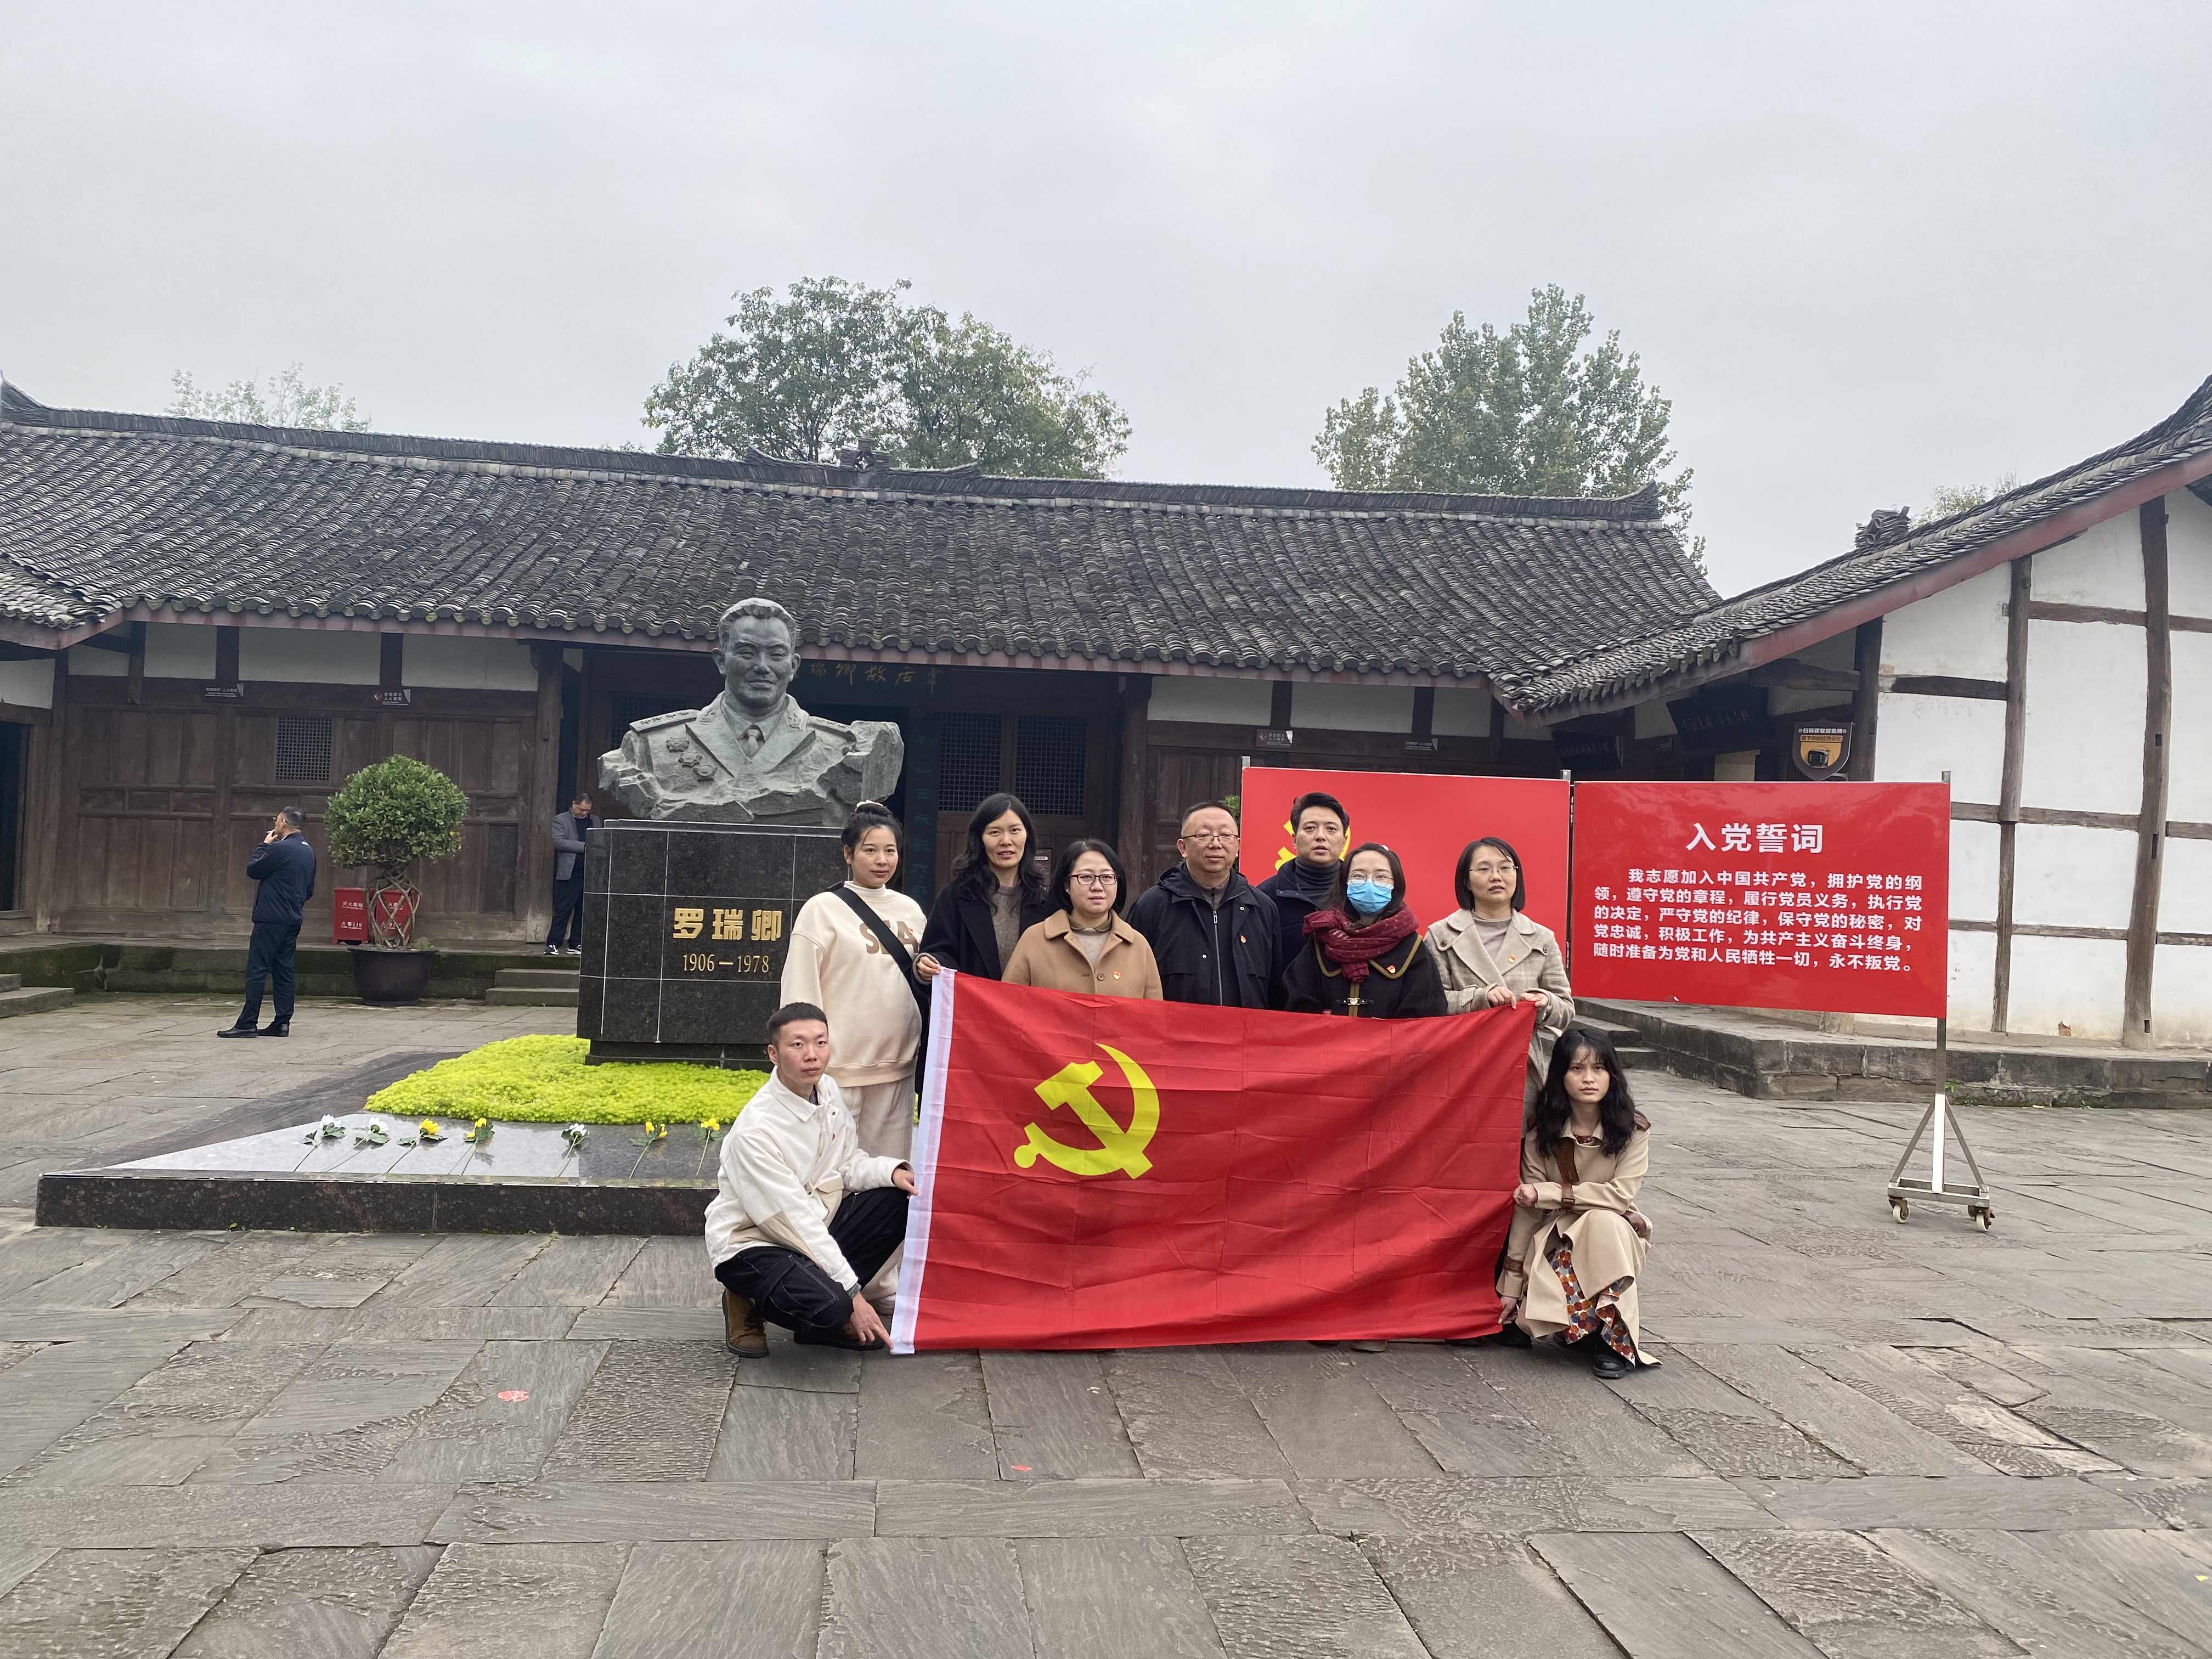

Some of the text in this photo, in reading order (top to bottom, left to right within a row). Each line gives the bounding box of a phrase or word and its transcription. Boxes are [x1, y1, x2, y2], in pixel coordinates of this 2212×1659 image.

[1685, 822, 1823, 854] 入党誓词
[1628, 868, 1922, 891] 我志愿加入中国共产党，拥护党的纲
[1594, 886, 1922, 911] 领，遵守党的章程，履行党员义务，执行党
[673, 908, 782, 941] 罗瑞卿
[1594, 905, 1922, 932] 的决定，严守党的纪律，保守党的秘密，对
[1594, 924, 1911, 952] 党忠诚，积极工作，为共产主义奋斗终身，
[1593, 943, 1911, 972] 随时准备为党和人民牺牲一切，永不叛党。
